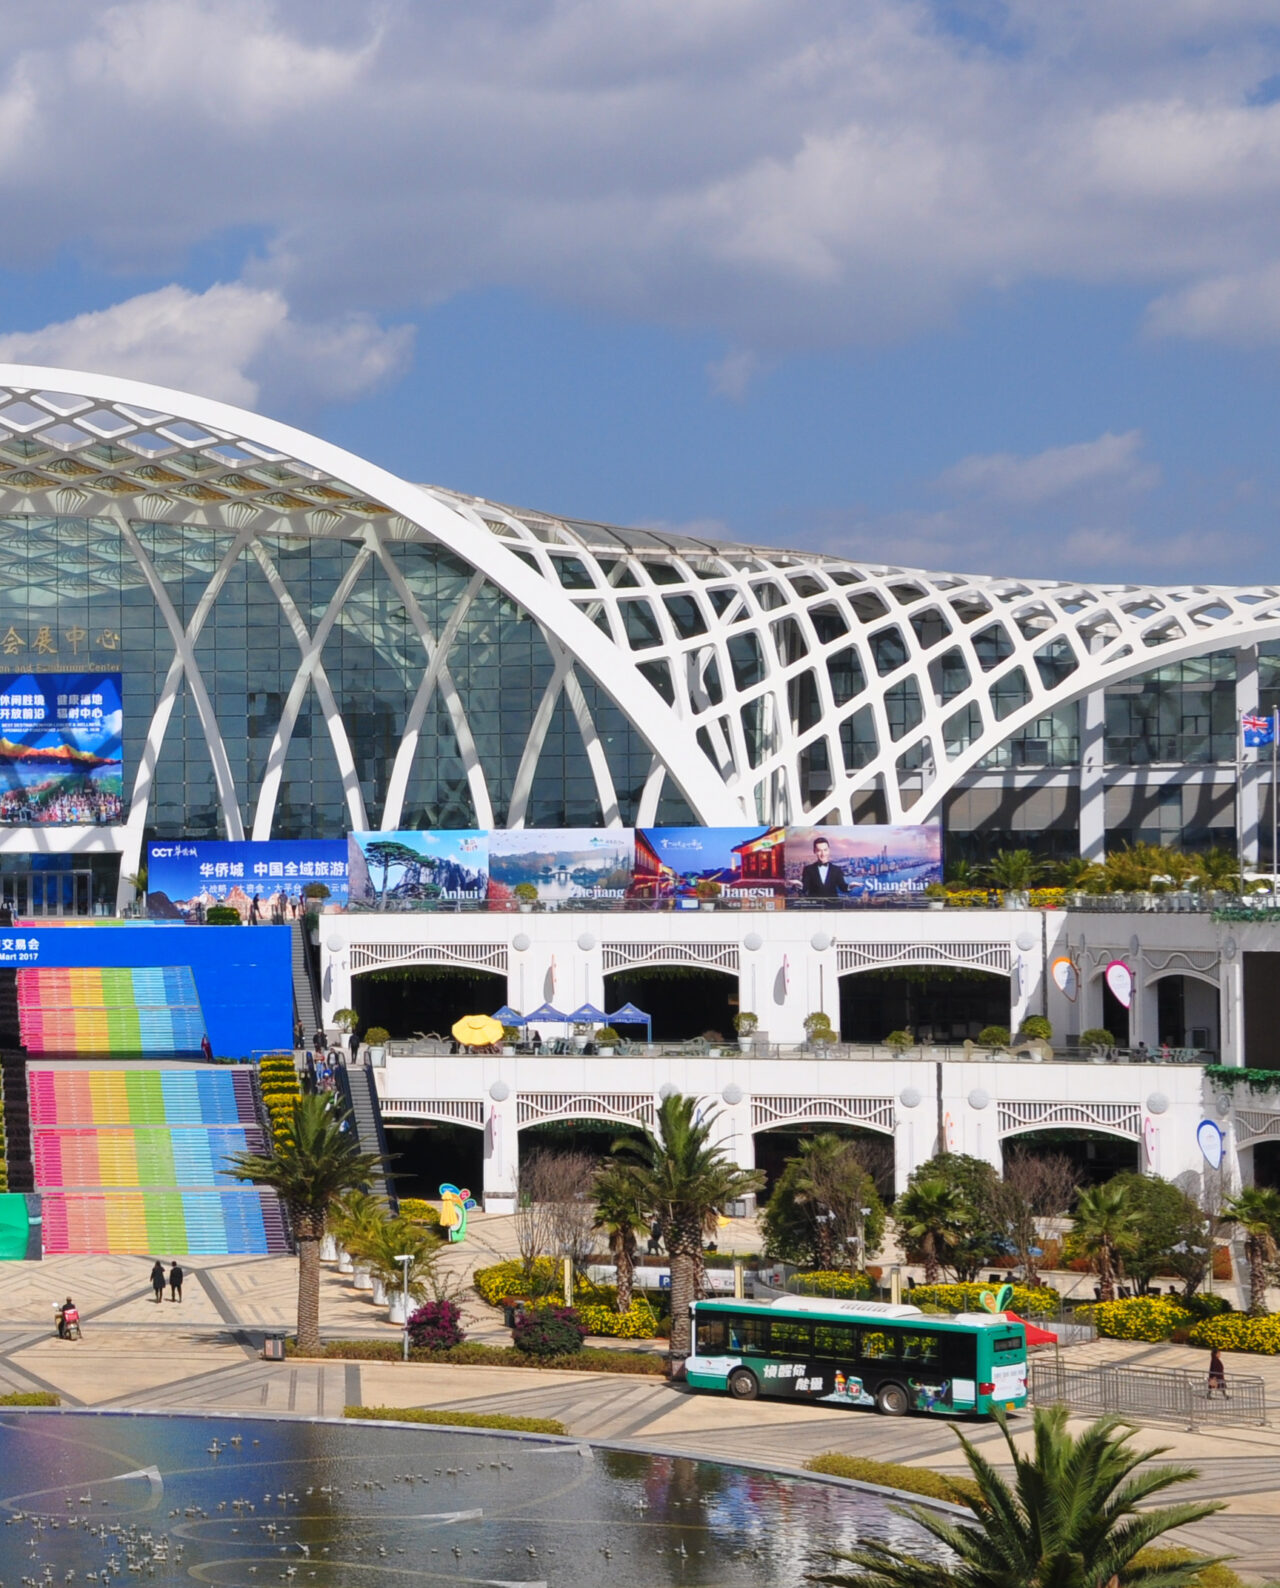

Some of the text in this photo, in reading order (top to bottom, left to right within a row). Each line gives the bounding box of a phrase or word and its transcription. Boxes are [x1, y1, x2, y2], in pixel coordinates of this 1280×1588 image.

[151, 848, 173, 858] OCT
[199, 862, 244, 878] 华侨城
[438, 886, 478, 900] Anhui
[718, 884, 775, 899] Jiangsu
[864, 878, 929, 895] Shanghai
[18, 952, 39, 961] 2017
